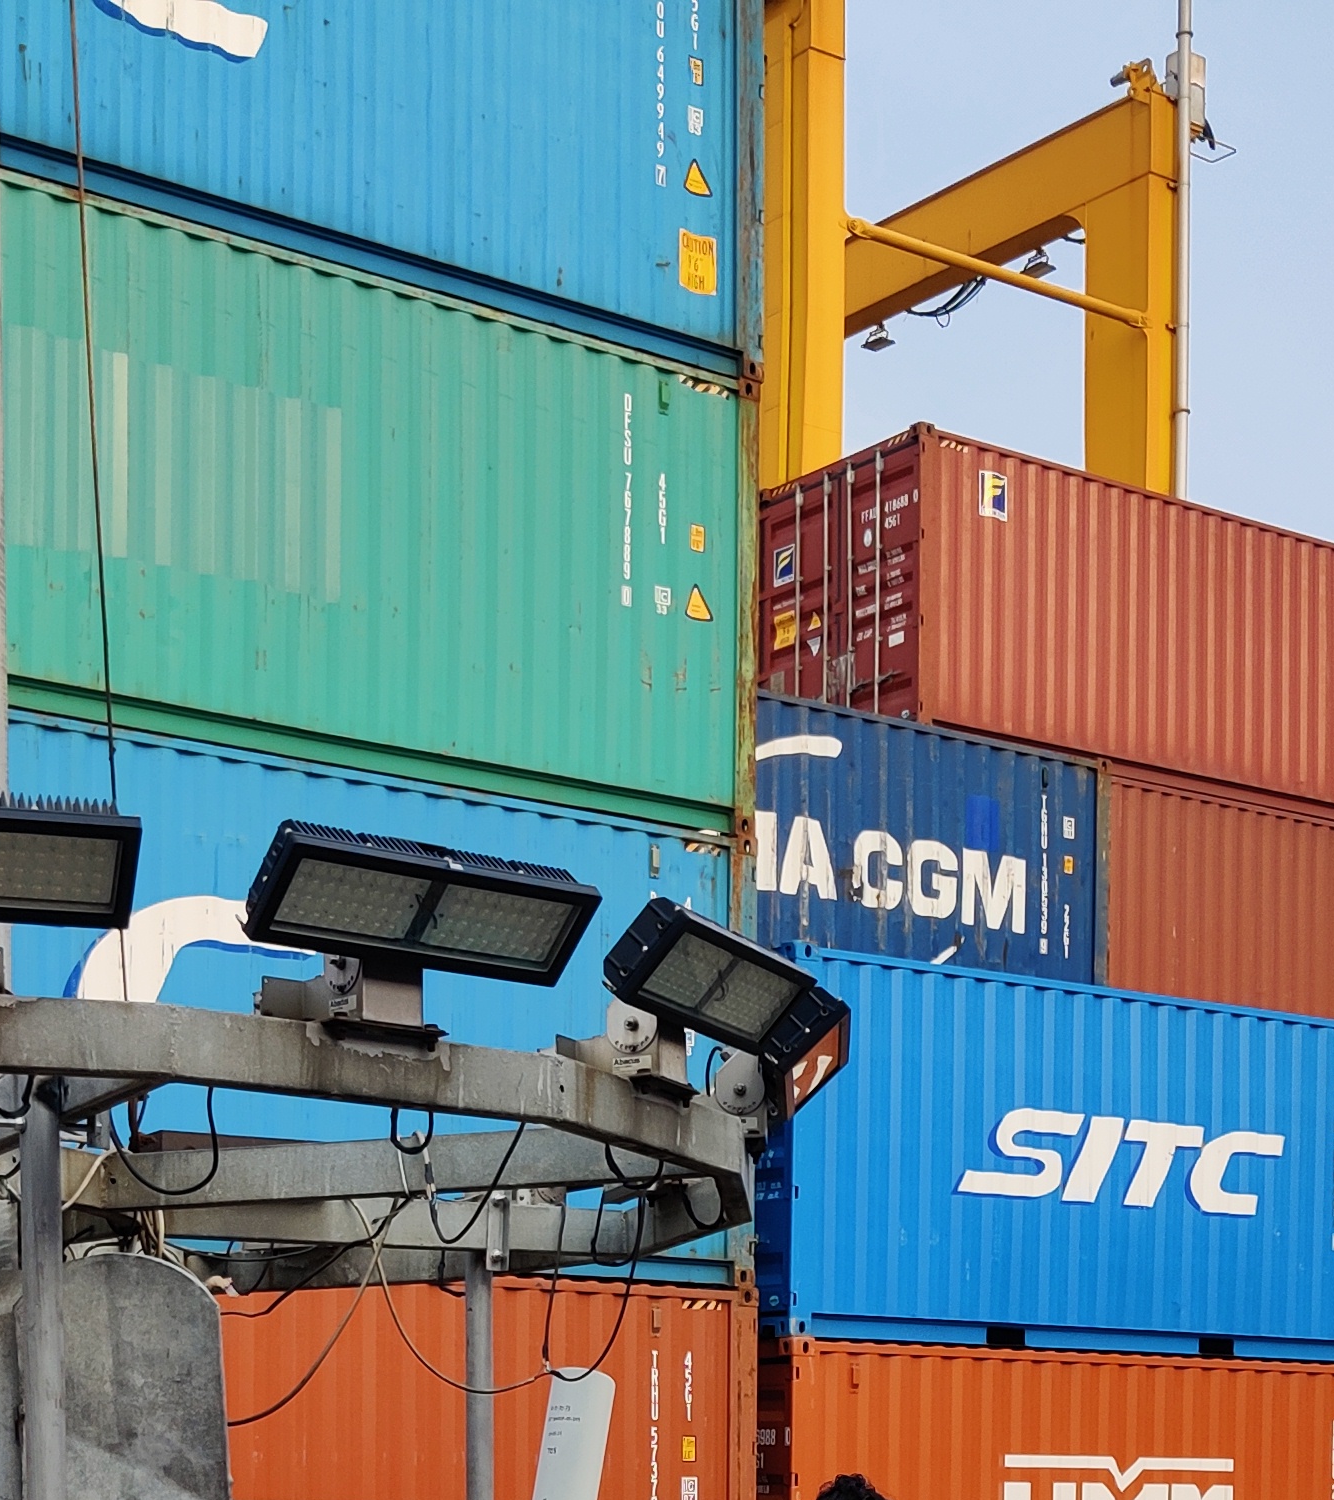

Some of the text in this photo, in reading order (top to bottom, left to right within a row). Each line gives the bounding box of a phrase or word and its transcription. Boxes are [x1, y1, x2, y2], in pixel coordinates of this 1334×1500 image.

[624, 393, 632, 466] DFSU
[623, 472, 632, 580] 767889
[658, 473, 667, 544] 45G1
[853, 829, 1026, 934] CGM
[613, 1057, 640, 1066] Abacus
[953, 1107, 1286, 1218] SITC
[651, 1350, 659, 1421] TRHU
[684, 1351, 693, 1422] 45G1
